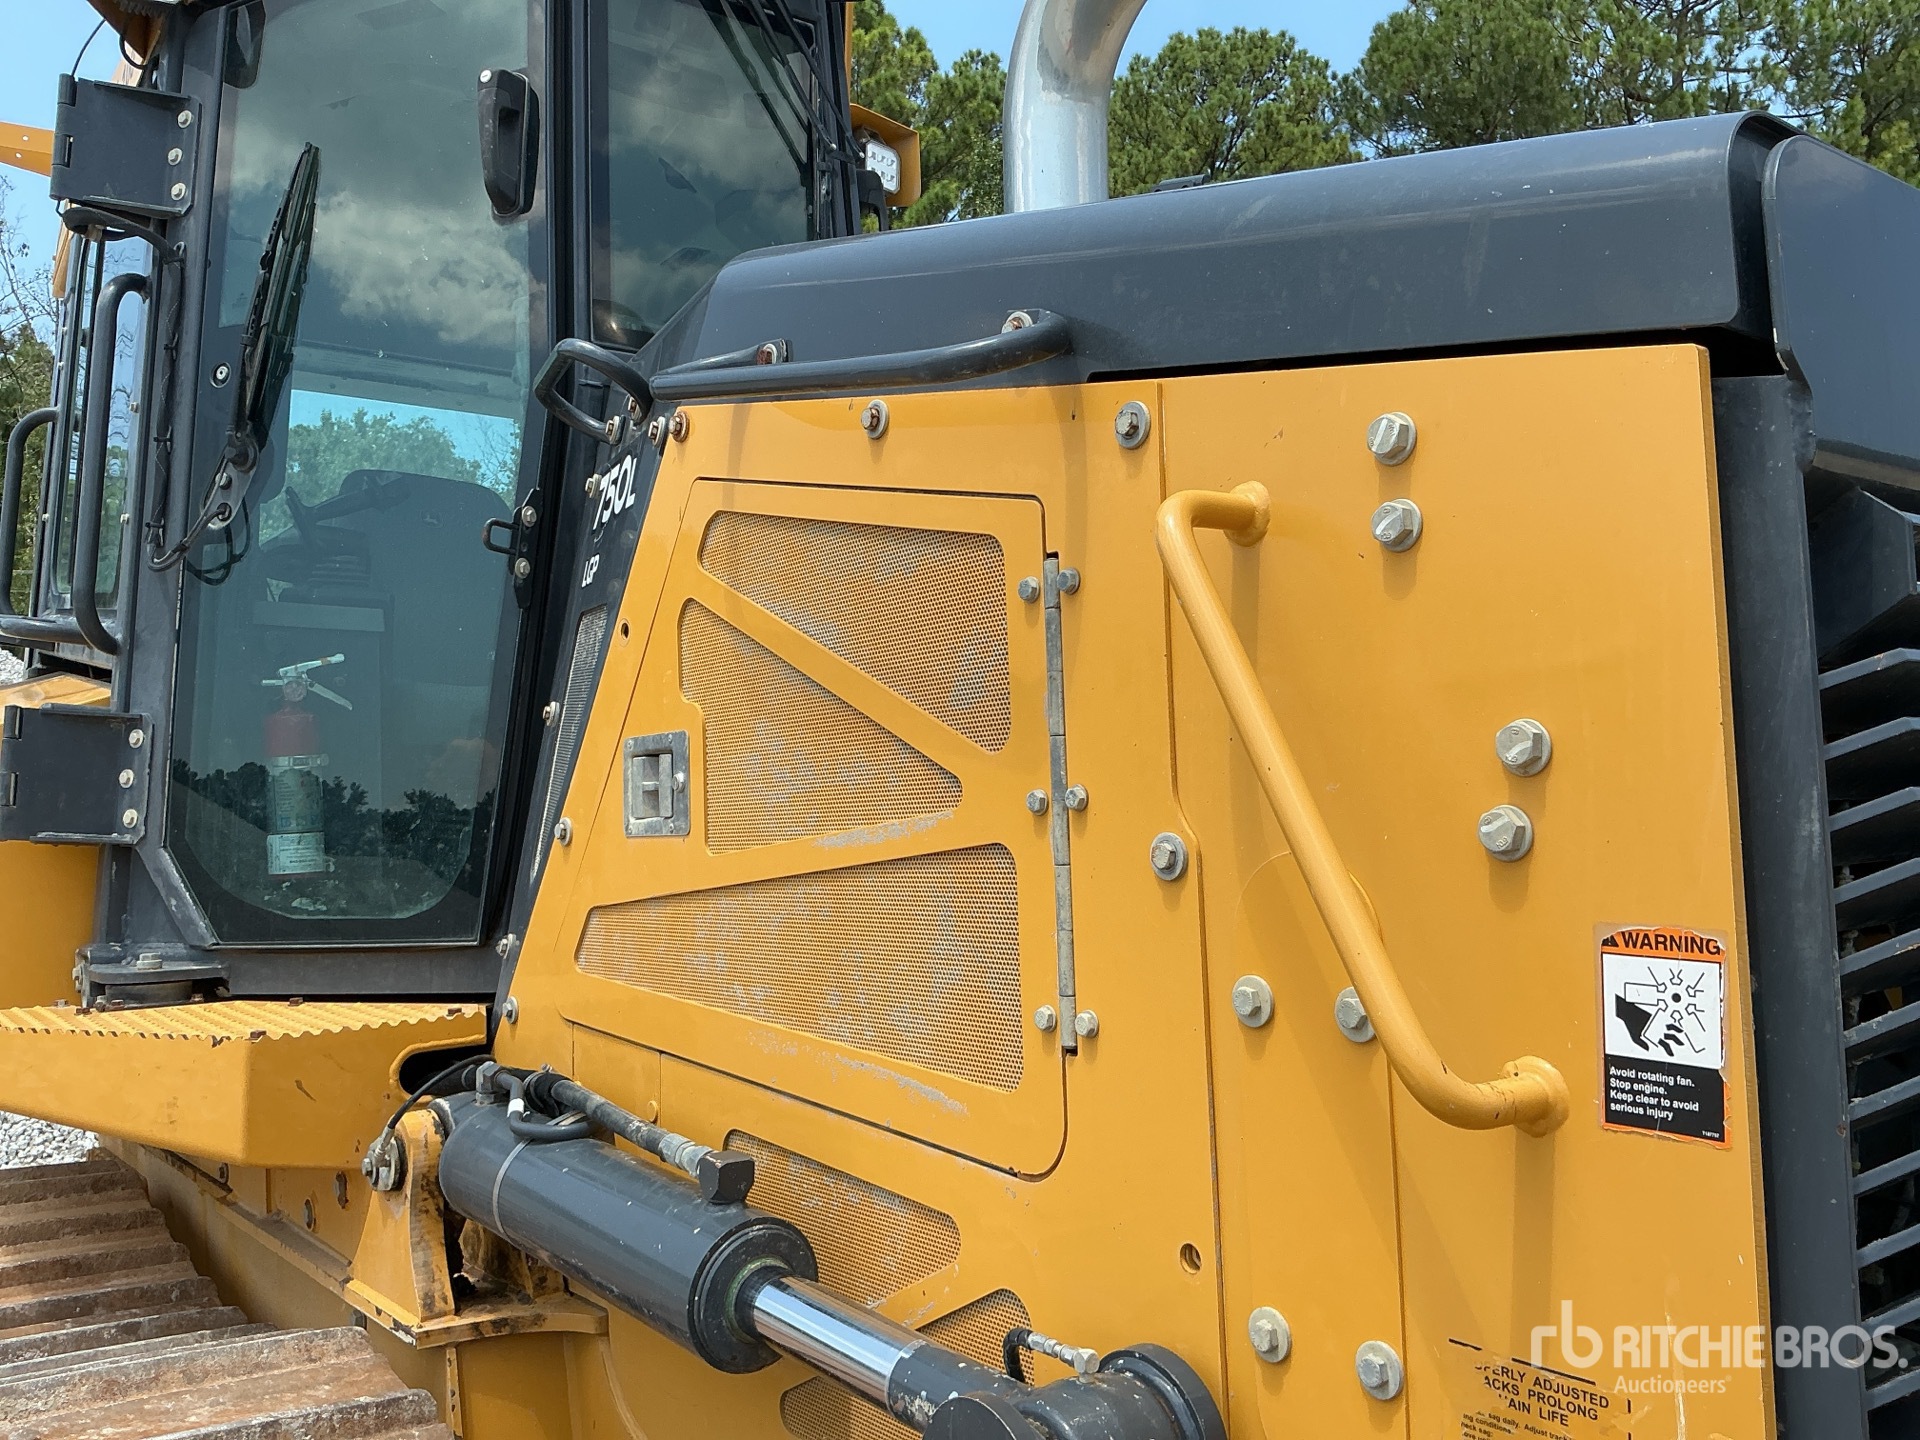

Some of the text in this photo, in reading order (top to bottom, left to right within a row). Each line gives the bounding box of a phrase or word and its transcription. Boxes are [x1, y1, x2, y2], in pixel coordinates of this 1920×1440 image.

[592, 454, 638, 530] 750L
[581, 554, 600, 588] LGP
[1620, 931, 1721, 956] WARNING
[1609, 1066, 1695, 1087] Avoid rotating fan.
[1609, 1078, 1668, 1095] Stop engine.
[1609, 1089, 1699, 1111] Keep clear to avoid
[1610, 1102, 1674, 1121] serious injury
[1533, 1376, 1609, 1409] ADJUSTED
[1527, 1388, 1599, 1421] PROLONG
[1539, 1407, 1569, 1427] LIFE
[1524, 1423, 1548, 1437] Adjust
